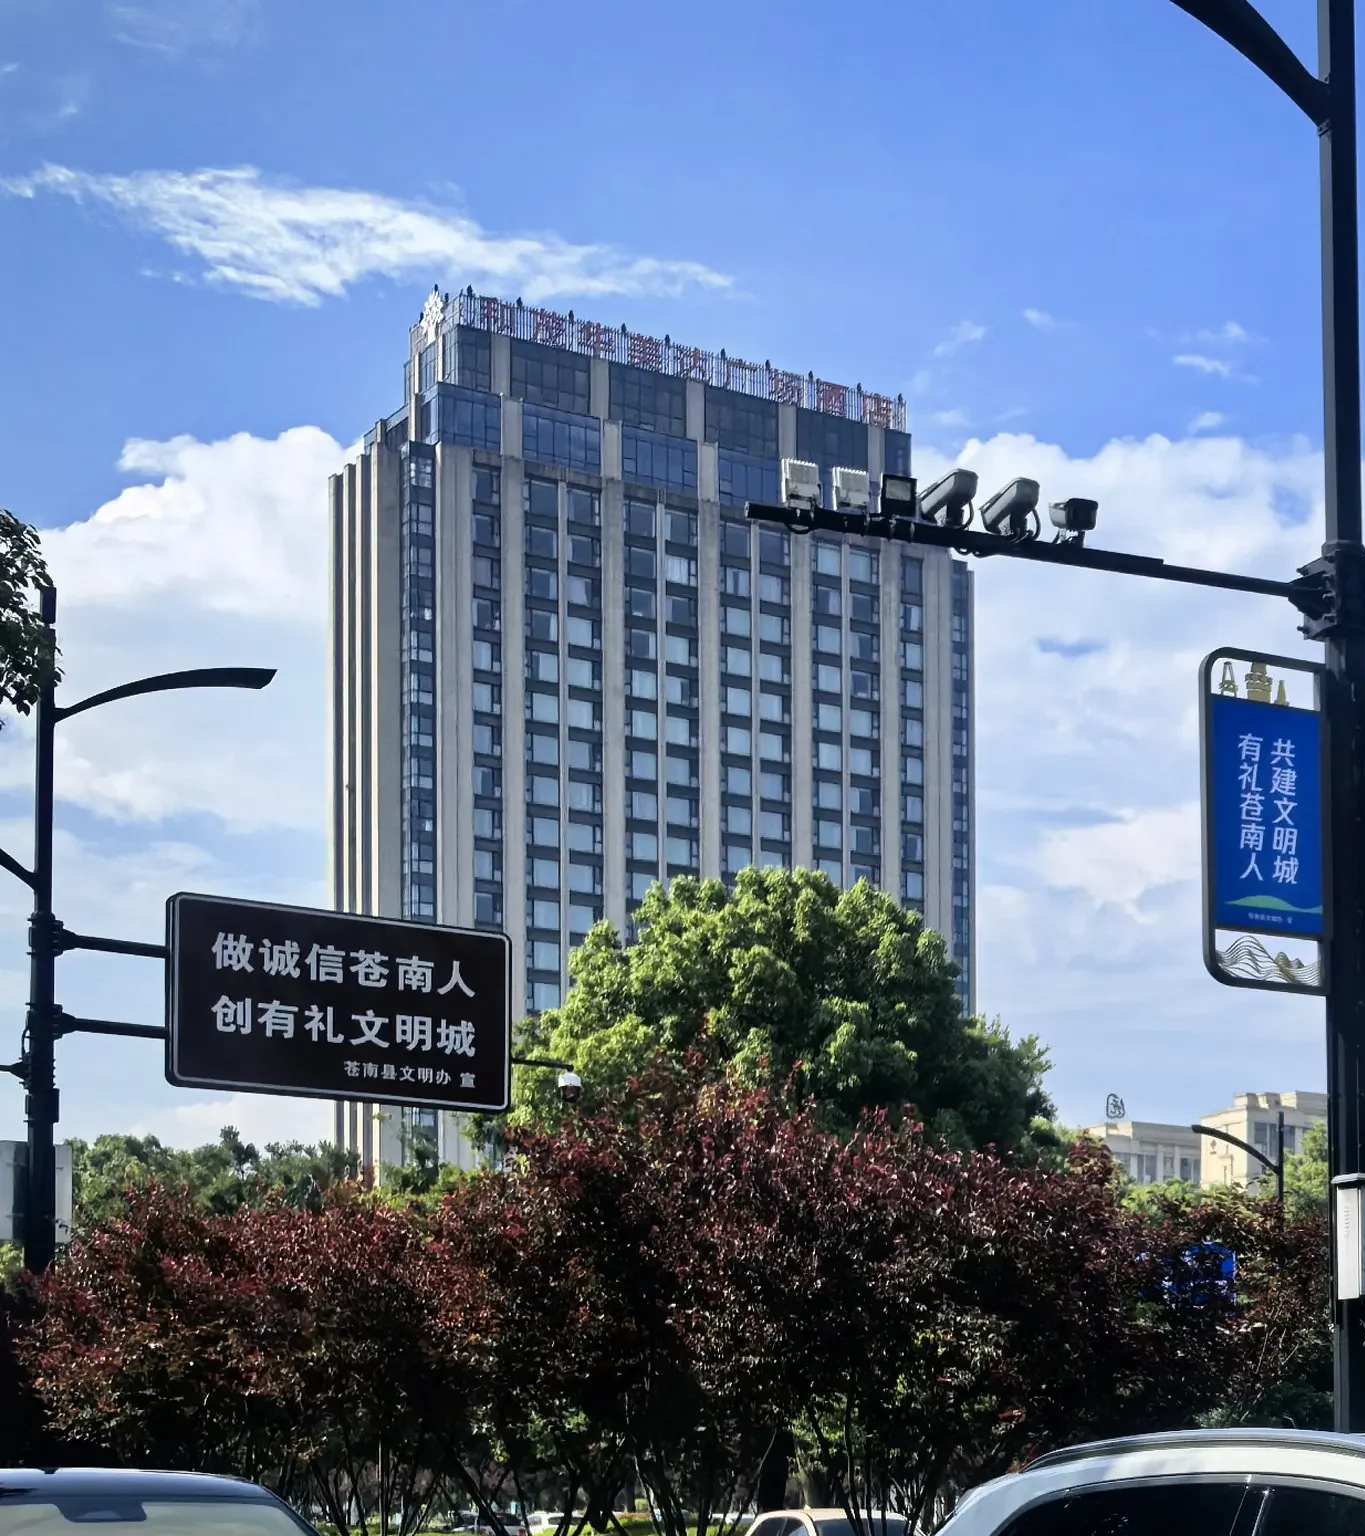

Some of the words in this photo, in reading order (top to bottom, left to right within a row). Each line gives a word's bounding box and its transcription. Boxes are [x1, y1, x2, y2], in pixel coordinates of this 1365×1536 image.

[1237, 732, 1266, 882] 有礼苍南人
[1269, 737, 1299, 885] 共建文明城
[211, 931, 476, 998] 做诚信苍南人
[210, 994, 477, 1058] 创有礼文明城
[343, 1060, 452, 1086] 苍南县文明办
[459, 1072, 477, 1089] 宣
